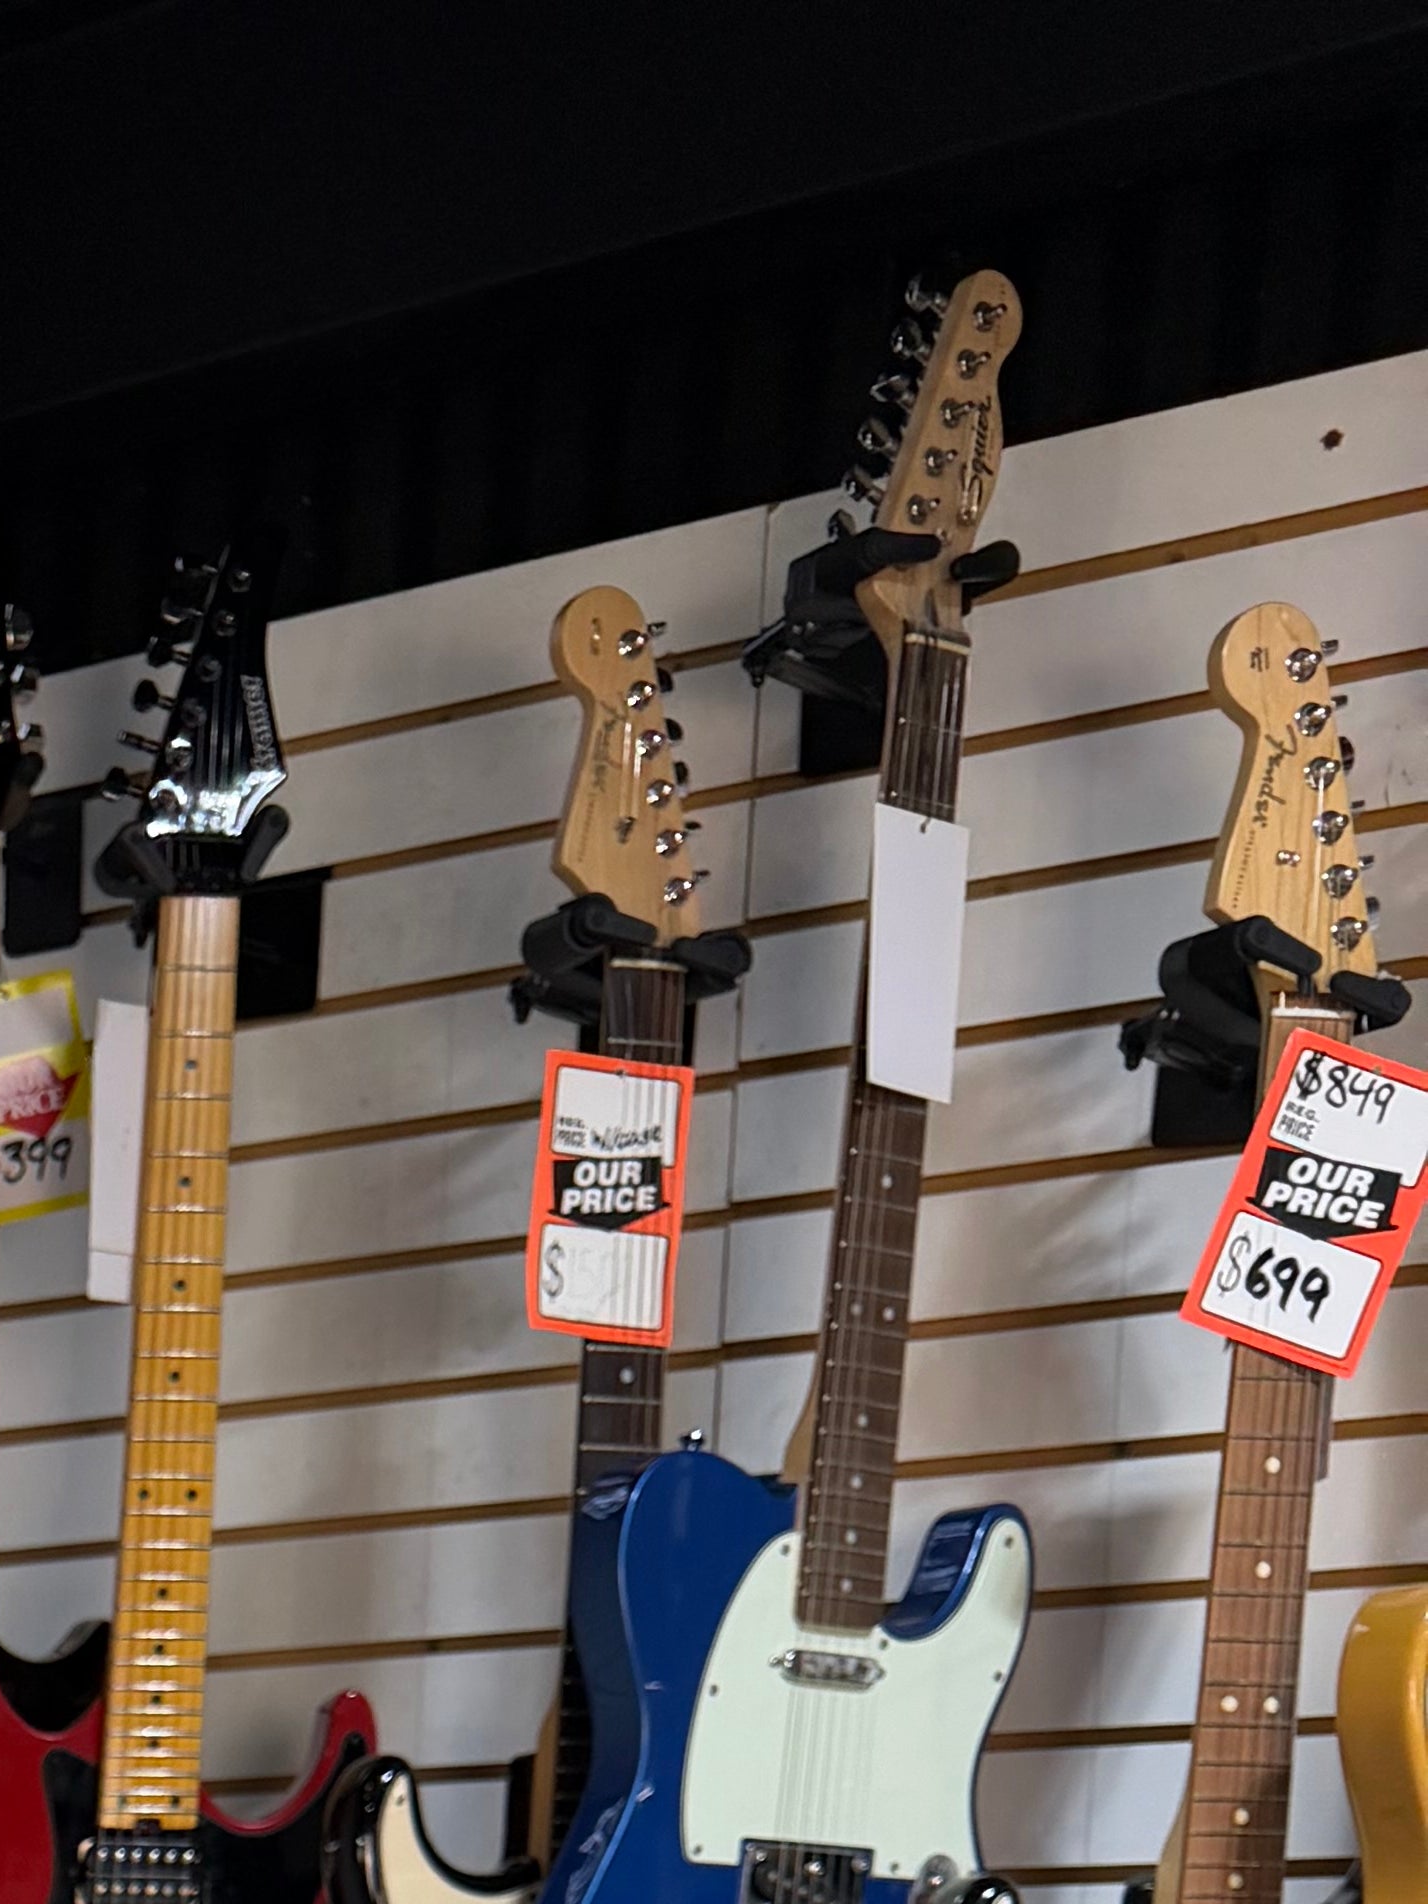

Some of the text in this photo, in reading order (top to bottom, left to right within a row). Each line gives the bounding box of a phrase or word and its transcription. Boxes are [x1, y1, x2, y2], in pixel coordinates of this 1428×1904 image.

[1252, 723, 1299, 829] Fender
[1295, 1051, 1396, 1126] $849
[573, 1160, 642, 1188] OUR
[1287, 1156, 1374, 1197] OUR
[560, 1185, 658, 1216] PRICE
[1260, 1180, 1386, 1230] PRICE
[1217, 1229, 1331, 1325] $699
